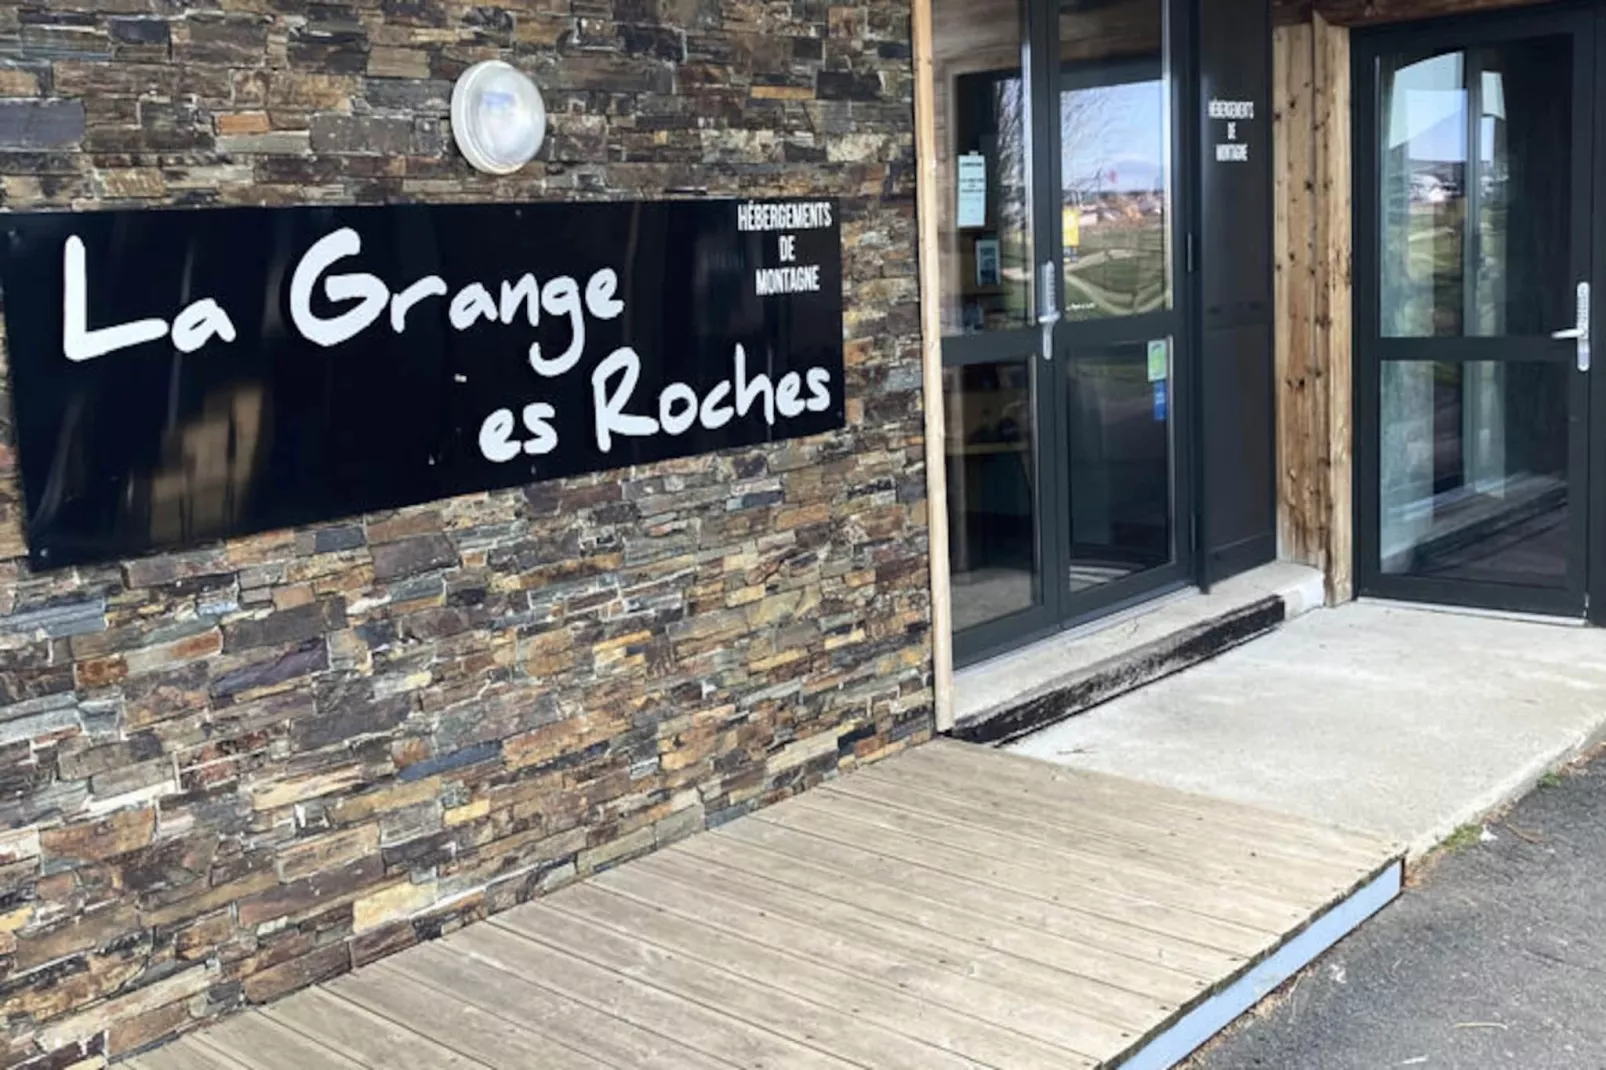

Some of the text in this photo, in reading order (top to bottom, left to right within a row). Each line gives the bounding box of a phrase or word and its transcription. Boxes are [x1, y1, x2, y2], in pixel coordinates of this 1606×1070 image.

[738, 200, 832, 231] HÉBERGEMENTS
[779, 235, 796, 262] DE
[755, 265, 820, 295] MONTAGNE
[64, 228, 624, 376] La Grange
[479, 344, 829, 461] es Roches
